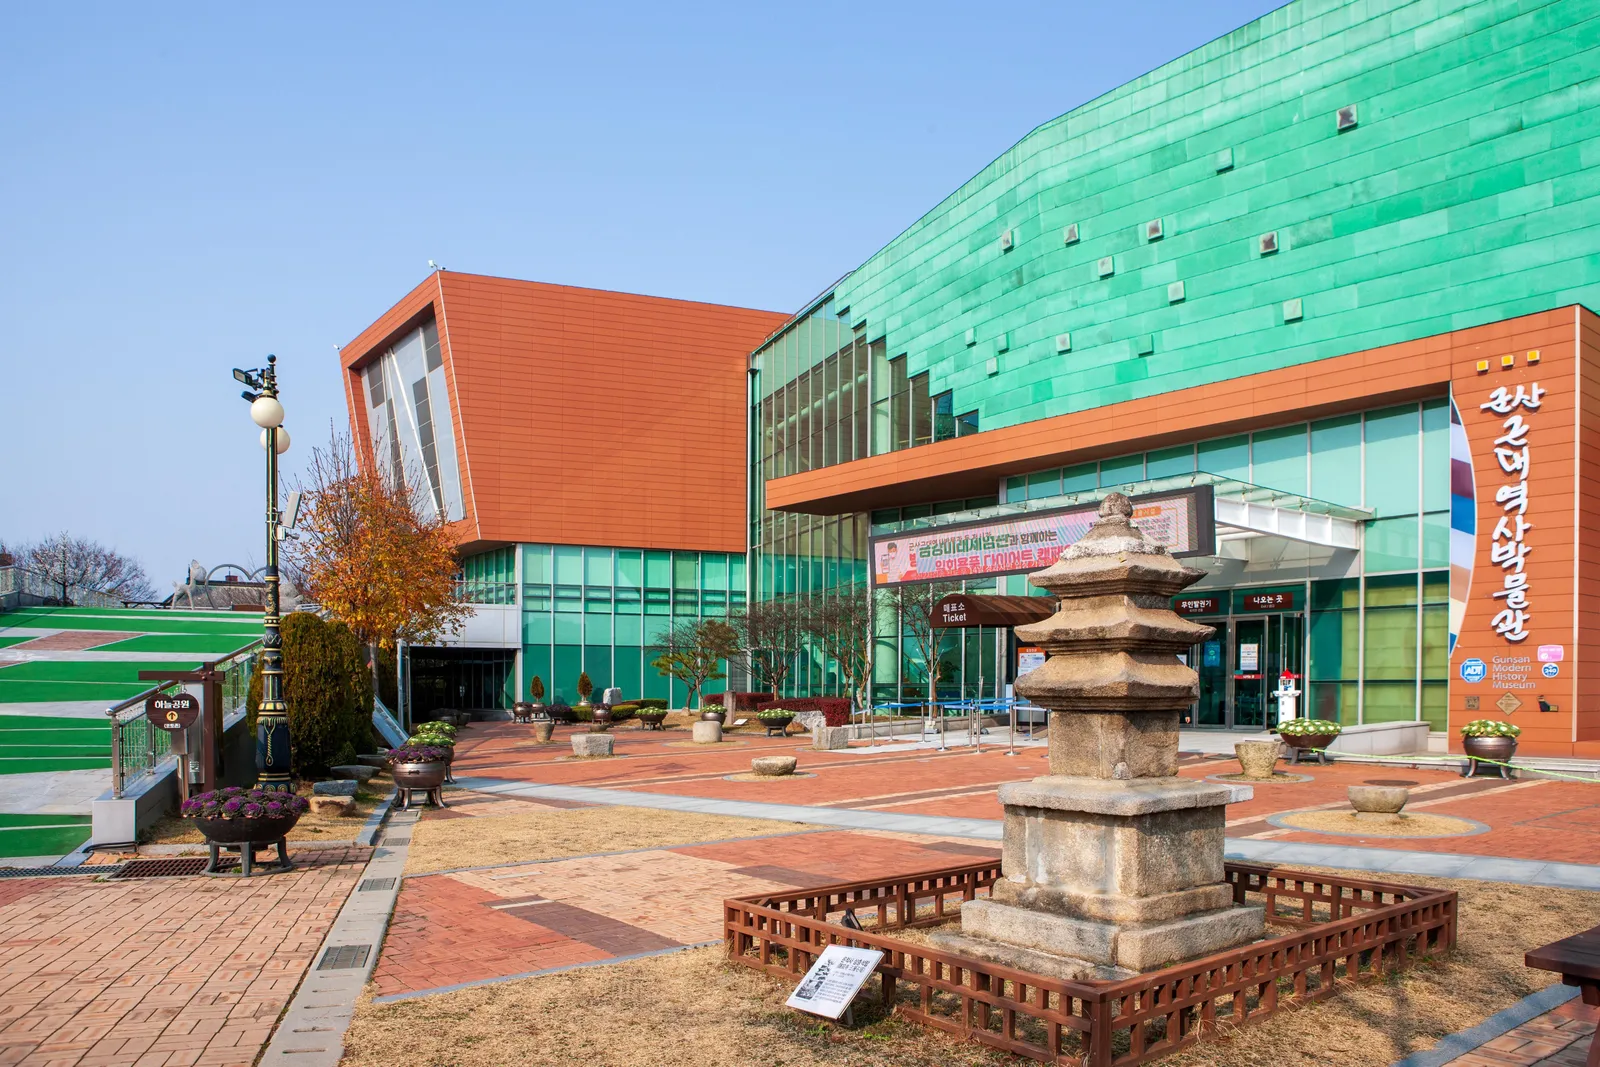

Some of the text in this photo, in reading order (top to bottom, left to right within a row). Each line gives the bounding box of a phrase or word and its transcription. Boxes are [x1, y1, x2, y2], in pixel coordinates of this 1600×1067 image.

[1480, 381, 1547, 641] 군산 근대역사박물관
[1020, 529, 1058, 545] 함께하는
[1253, 594, 1283, 604] 나오는 곳
[942, 602, 966, 613] 매표소
[942, 612, 967, 623] Ticket
[1492, 655, 1530, 664] Gunsan
[1465, 666, 1482, 675] ADT
[1492, 664, 1532, 672] Modern
[1492, 673, 1528, 682] History
[1492, 681, 1536, 689] Museum
[155, 699, 189, 708] 하늘공원
